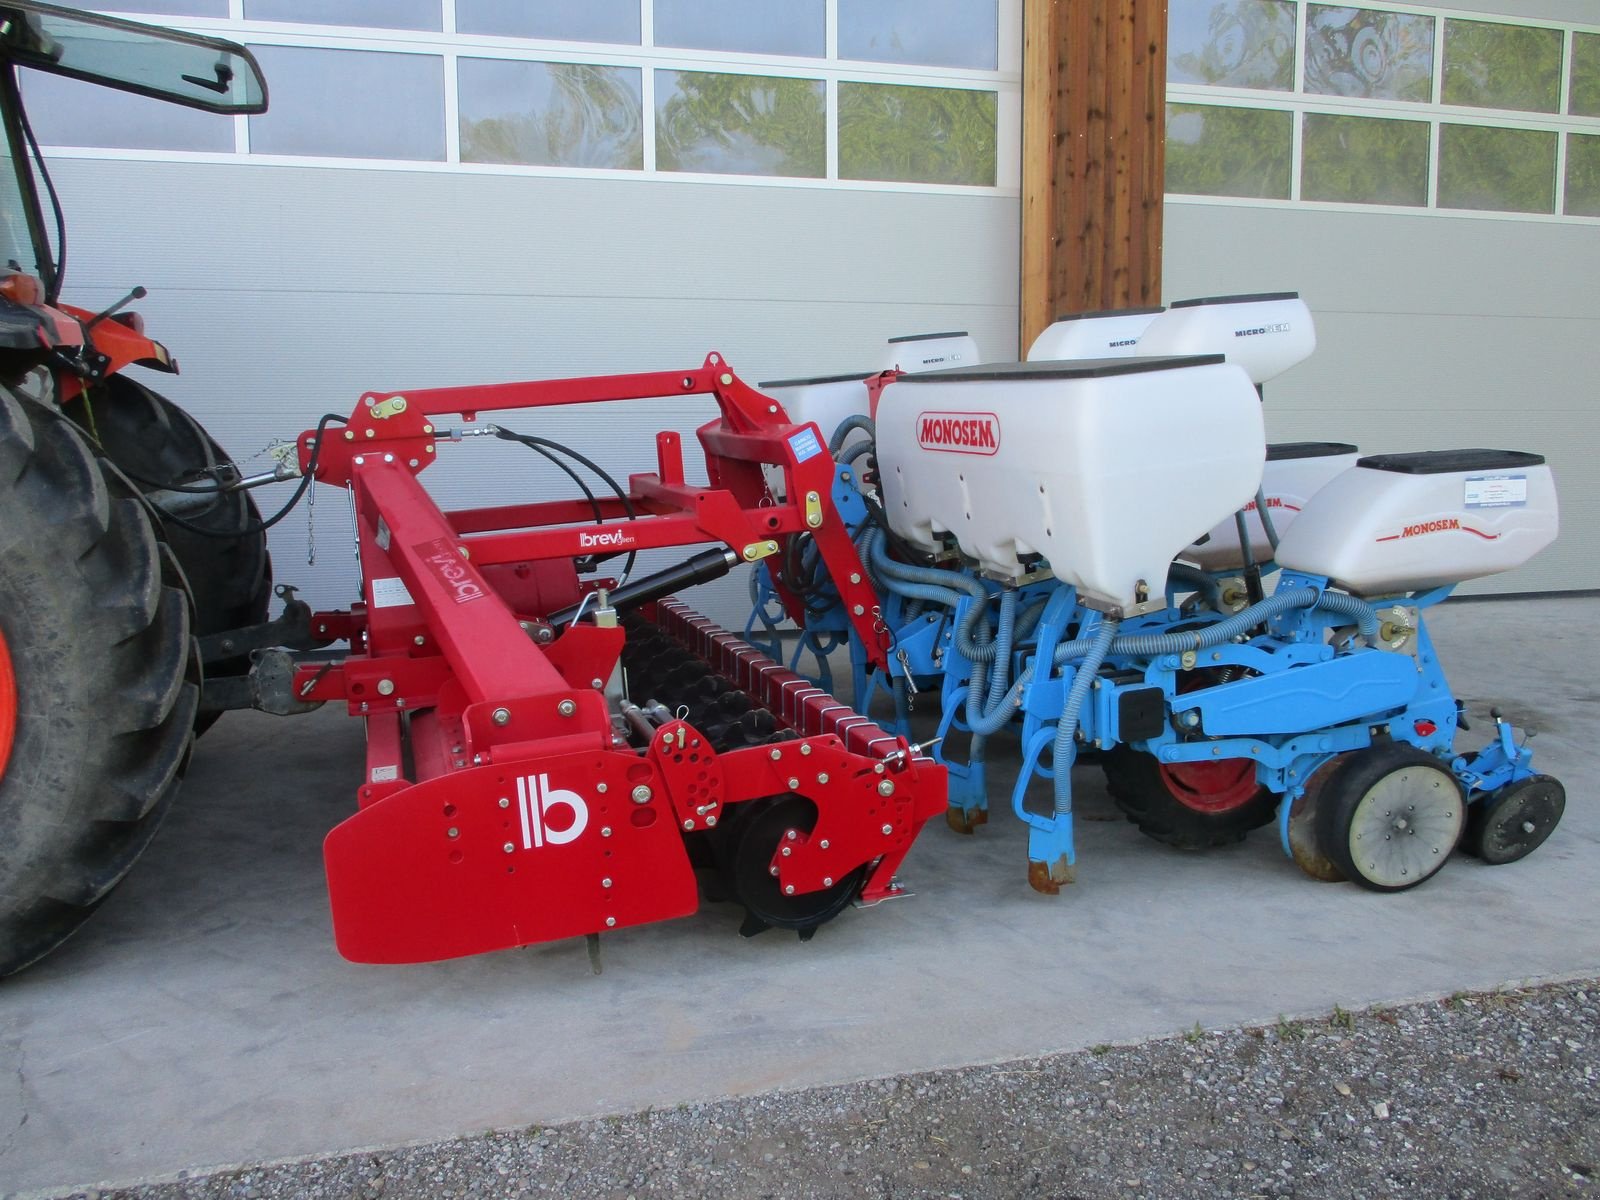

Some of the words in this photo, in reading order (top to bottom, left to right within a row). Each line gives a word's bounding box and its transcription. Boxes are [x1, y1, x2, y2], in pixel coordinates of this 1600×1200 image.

[1235, 323, 1290, 337] MICROSEM
[920, 418, 996, 448] MONOSEM
[1401, 519, 1460, 537] MONOSEM
[579, 529, 622, 547] brevi
